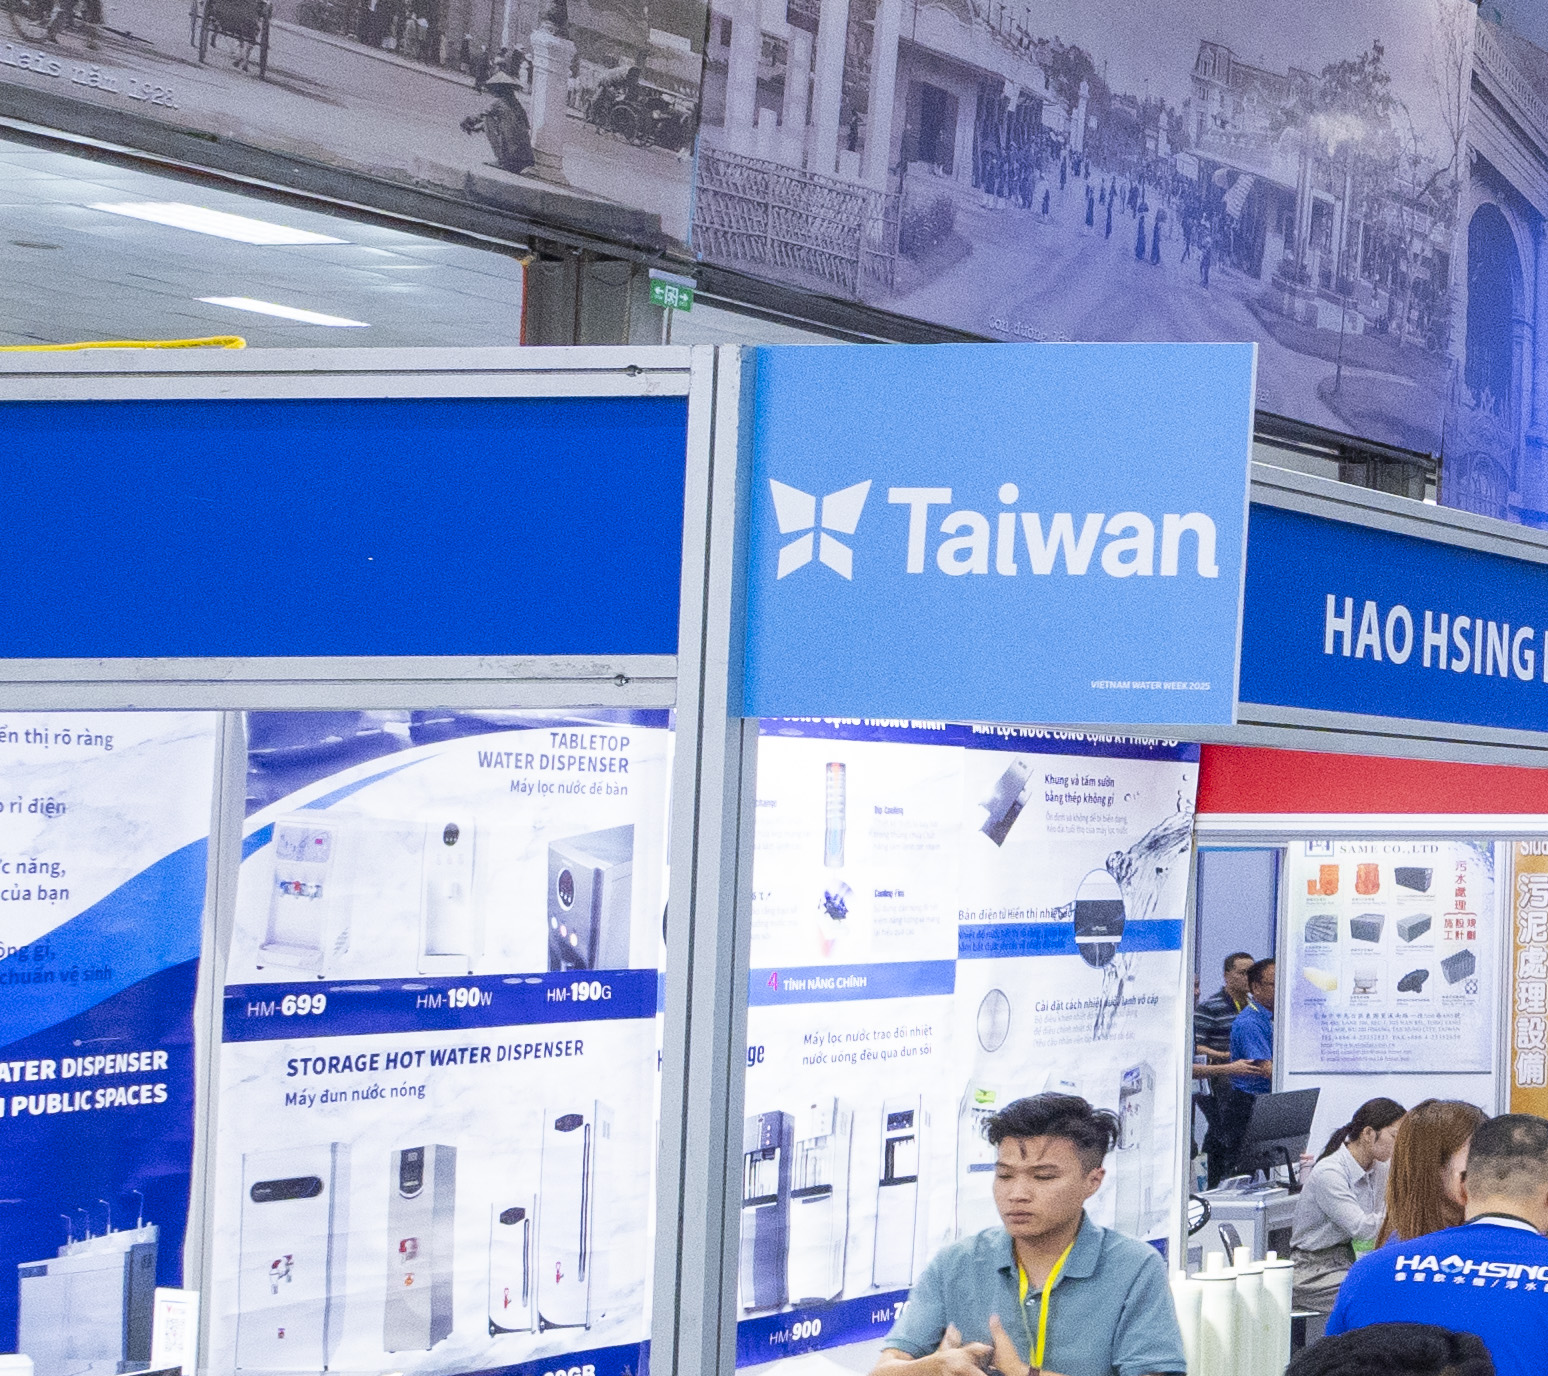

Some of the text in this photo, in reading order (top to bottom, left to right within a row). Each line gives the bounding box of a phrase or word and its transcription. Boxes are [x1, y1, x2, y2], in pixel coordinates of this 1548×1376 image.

[888, 482, 1219, 579] Taiwan
[1324, 593, 1414, 665] HAO
[1423, 611, 1535, 681] HSING
[1091, 679, 1211, 692] VIETNAM WATER WEEK 2025
[24, 728, 114, 750] thị rõ ràng
[550, 733, 630, 752] TABLETOP
[478, 751, 629, 774] WATER DISPENSER
[510, 779, 534, 795] Máy
[537, 780, 553, 796] lọc
[557, 780, 585, 795] nước
[606, 780, 628, 795] bàn
[1339, 844, 1439, 855] SAME CO.,LTD
[1454, 860, 1468, 911] 污水處理
[416, 987, 492, 1009] HM-190W
[546, 981, 612, 1003] HM-190G
[247, 993, 327, 1017] HM-699
[61, 1050, 169, 1079] DISPENSER
[286, 1039, 584, 1077] STORAGE HOT WATER DISPENSER
[12, 1083, 168, 1116] PUBLIC SPACES
[285, 1082, 426, 1108] Máy đun nước nóng
[769, 1318, 822, 1346] HM-900
